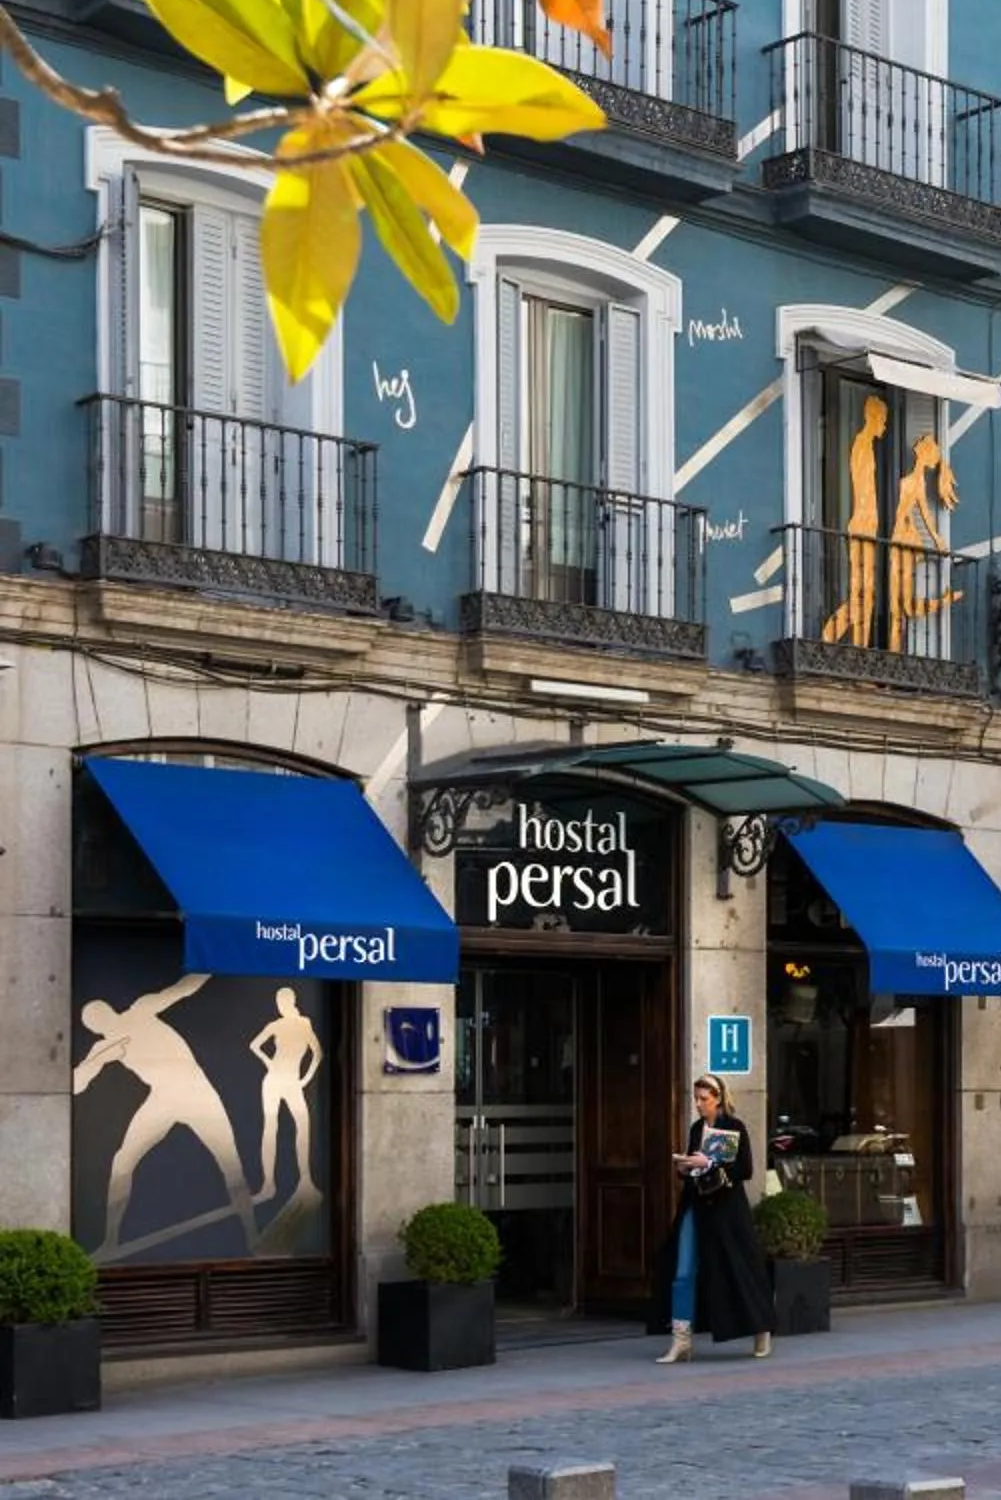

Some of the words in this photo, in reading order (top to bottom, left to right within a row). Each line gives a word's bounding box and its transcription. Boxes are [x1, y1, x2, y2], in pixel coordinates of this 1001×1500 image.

[518, 803, 634, 855] hostal
[488, 849, 640, 921] persal
[256, 921, 301, 941] hostal
[299, 927, 396, 971] persal
[915, 952, 947, 969] hostal
